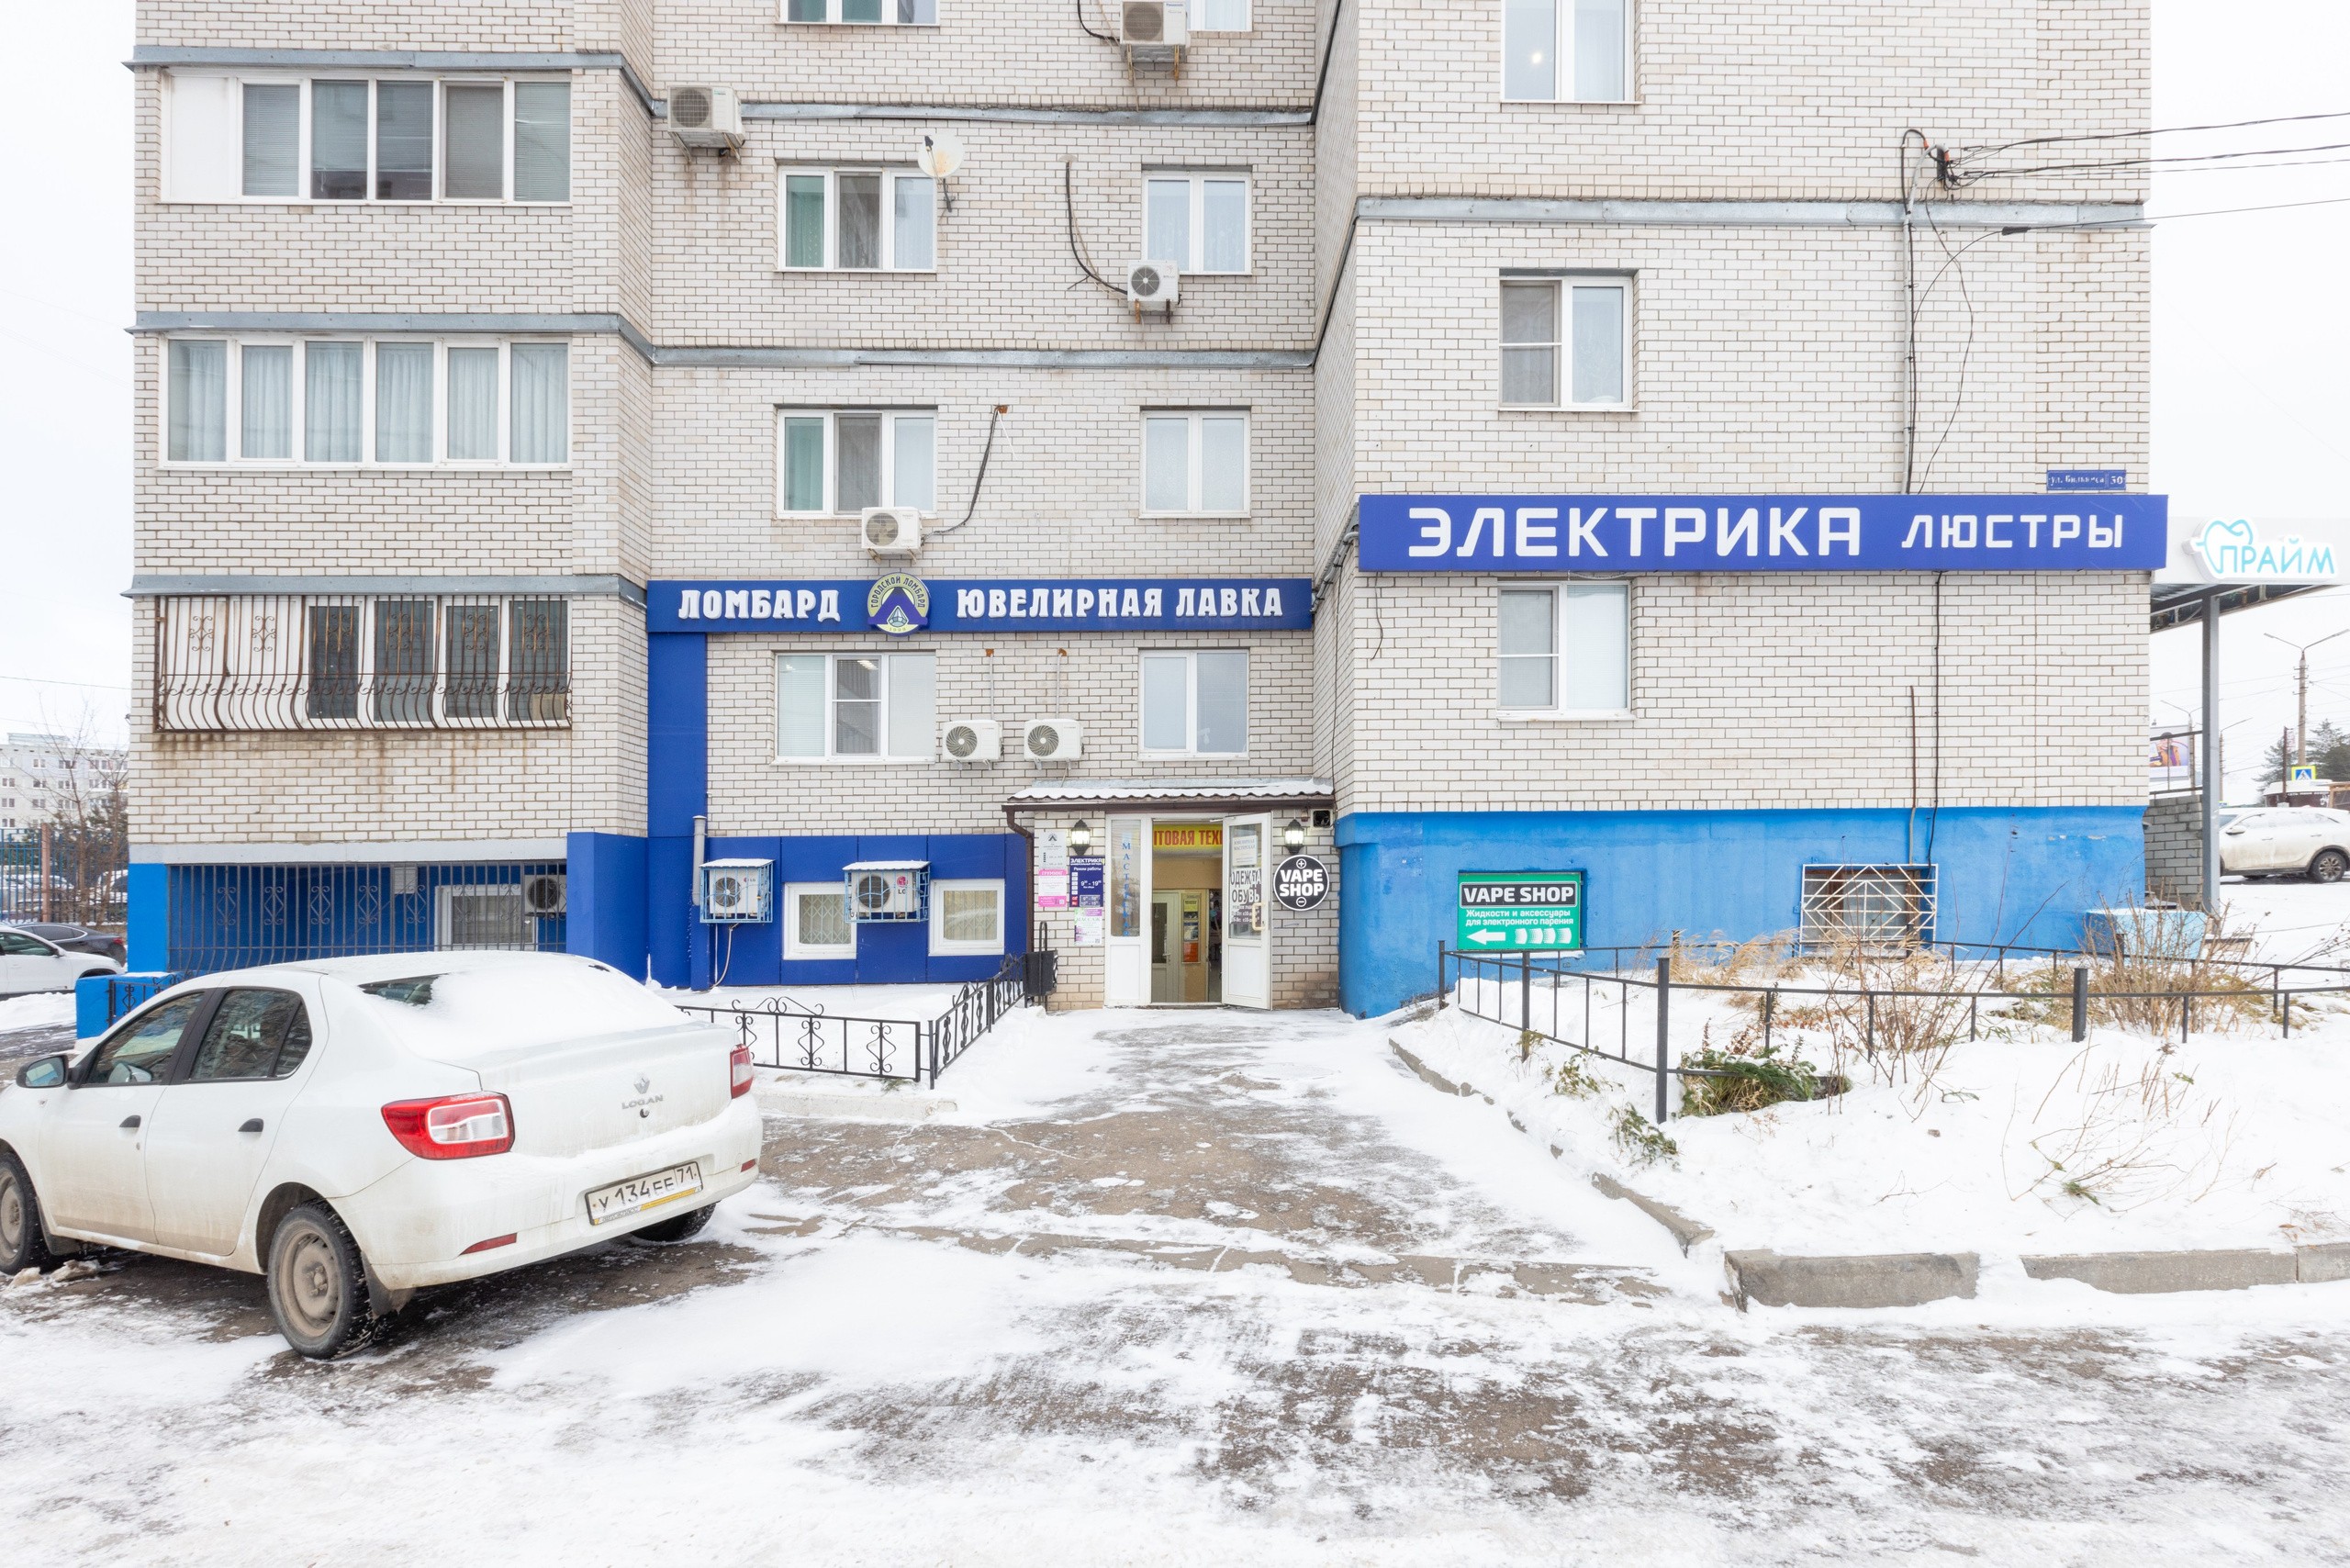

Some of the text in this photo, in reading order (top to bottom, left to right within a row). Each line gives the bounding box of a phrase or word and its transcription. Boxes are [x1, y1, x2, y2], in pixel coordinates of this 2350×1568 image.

[1407, 506, 2124, 558] ЭЛЕКТРИКА ЛЮСТРЫ
[2217, 537, 2335, 575] ПРАЙМ
[870, 575, 926, 609] ГОРОДСКОЙ ЛОМБАРД
[677, 589, 841, 622] ЛОМБАРД
[957, 588, 1283, 619] ЮВЕЛИРНАЯ ЛАВКА
[1230, 868, 1262, 888] ОДЕЖДА
[1280, 868, 1324, 882] VAPE
[1231, 889, 1260, 903] ОБУВЬ
[1279, 883, 1325, 897] SHOP
[1463, 886, 1574, 902] VAPE SHOP
[1465, 909, 1510, 918] Жидкости
[1520, 909, 1571, 918] аксессуары
[1483, 918, 1539, 926] электронного
[1539, 918, 1574, 926] парения
[621, 1094, 664, 1110] LOGAN
